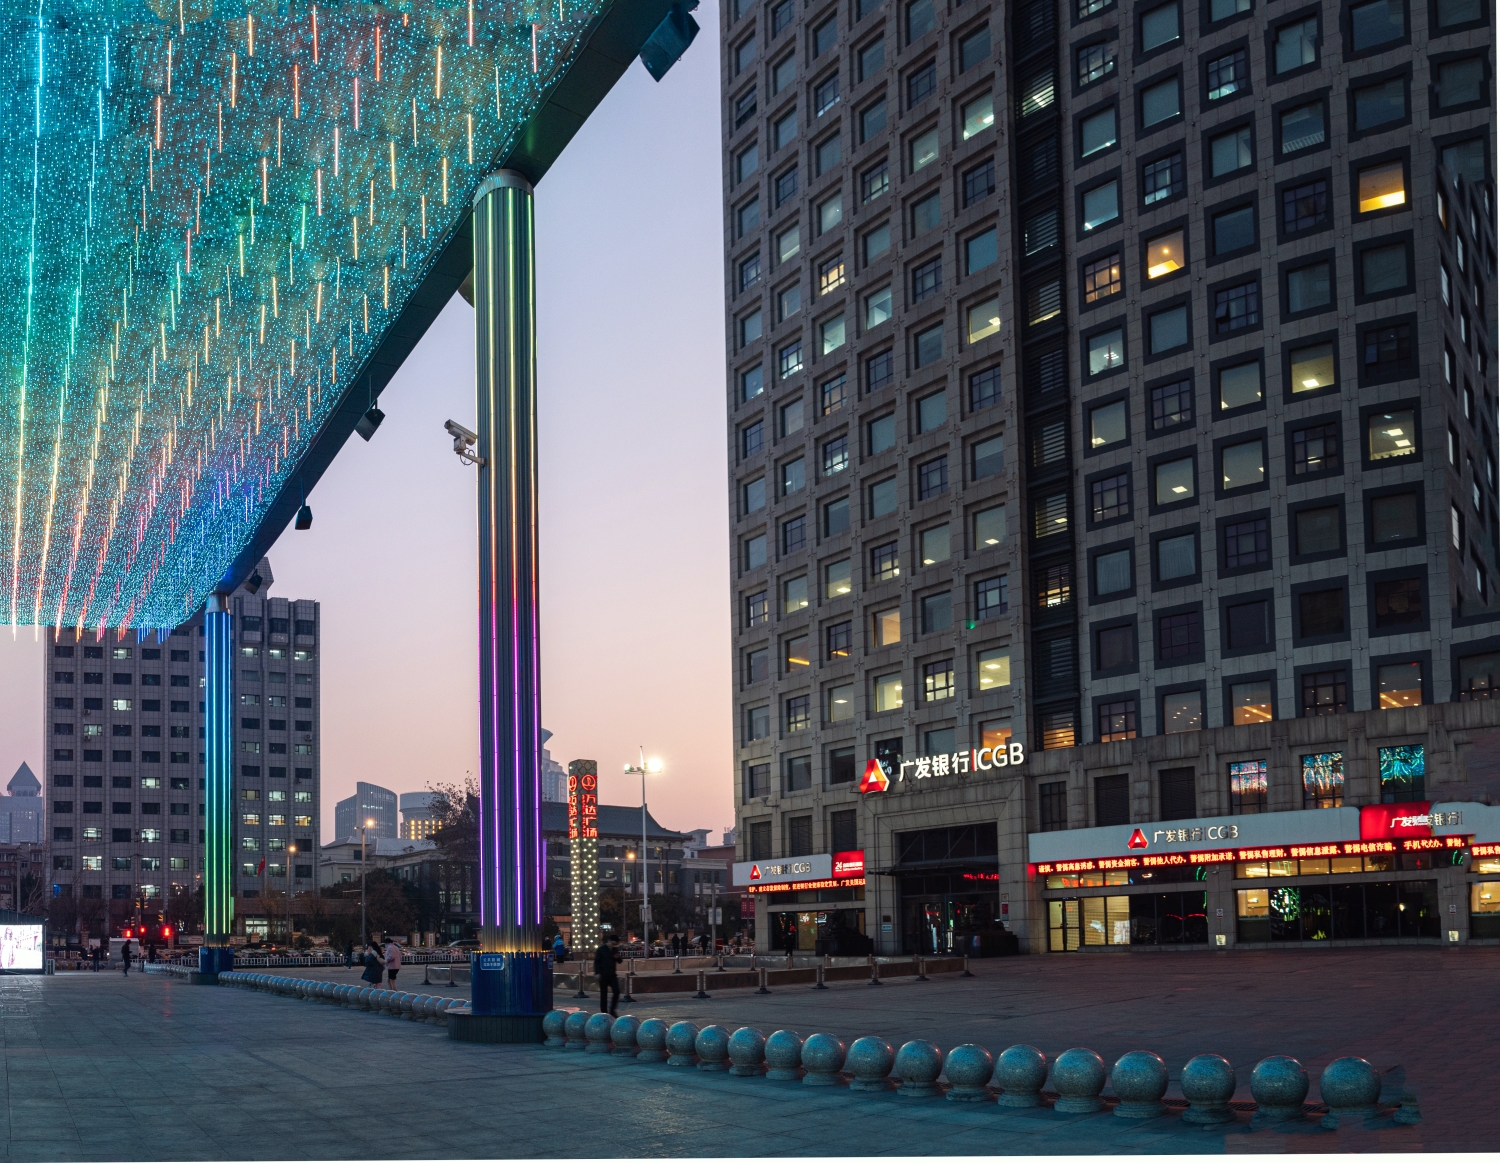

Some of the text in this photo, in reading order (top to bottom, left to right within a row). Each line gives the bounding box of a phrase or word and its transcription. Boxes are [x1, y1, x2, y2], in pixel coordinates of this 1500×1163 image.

[899, 742, 1025, 782] 广发银行 CGB
[583, 794, 597, 838] 万达广场
[1153, 825, 1239, 844] 广发银行 CGB
[764, 863, 792, 876] 广发银行
